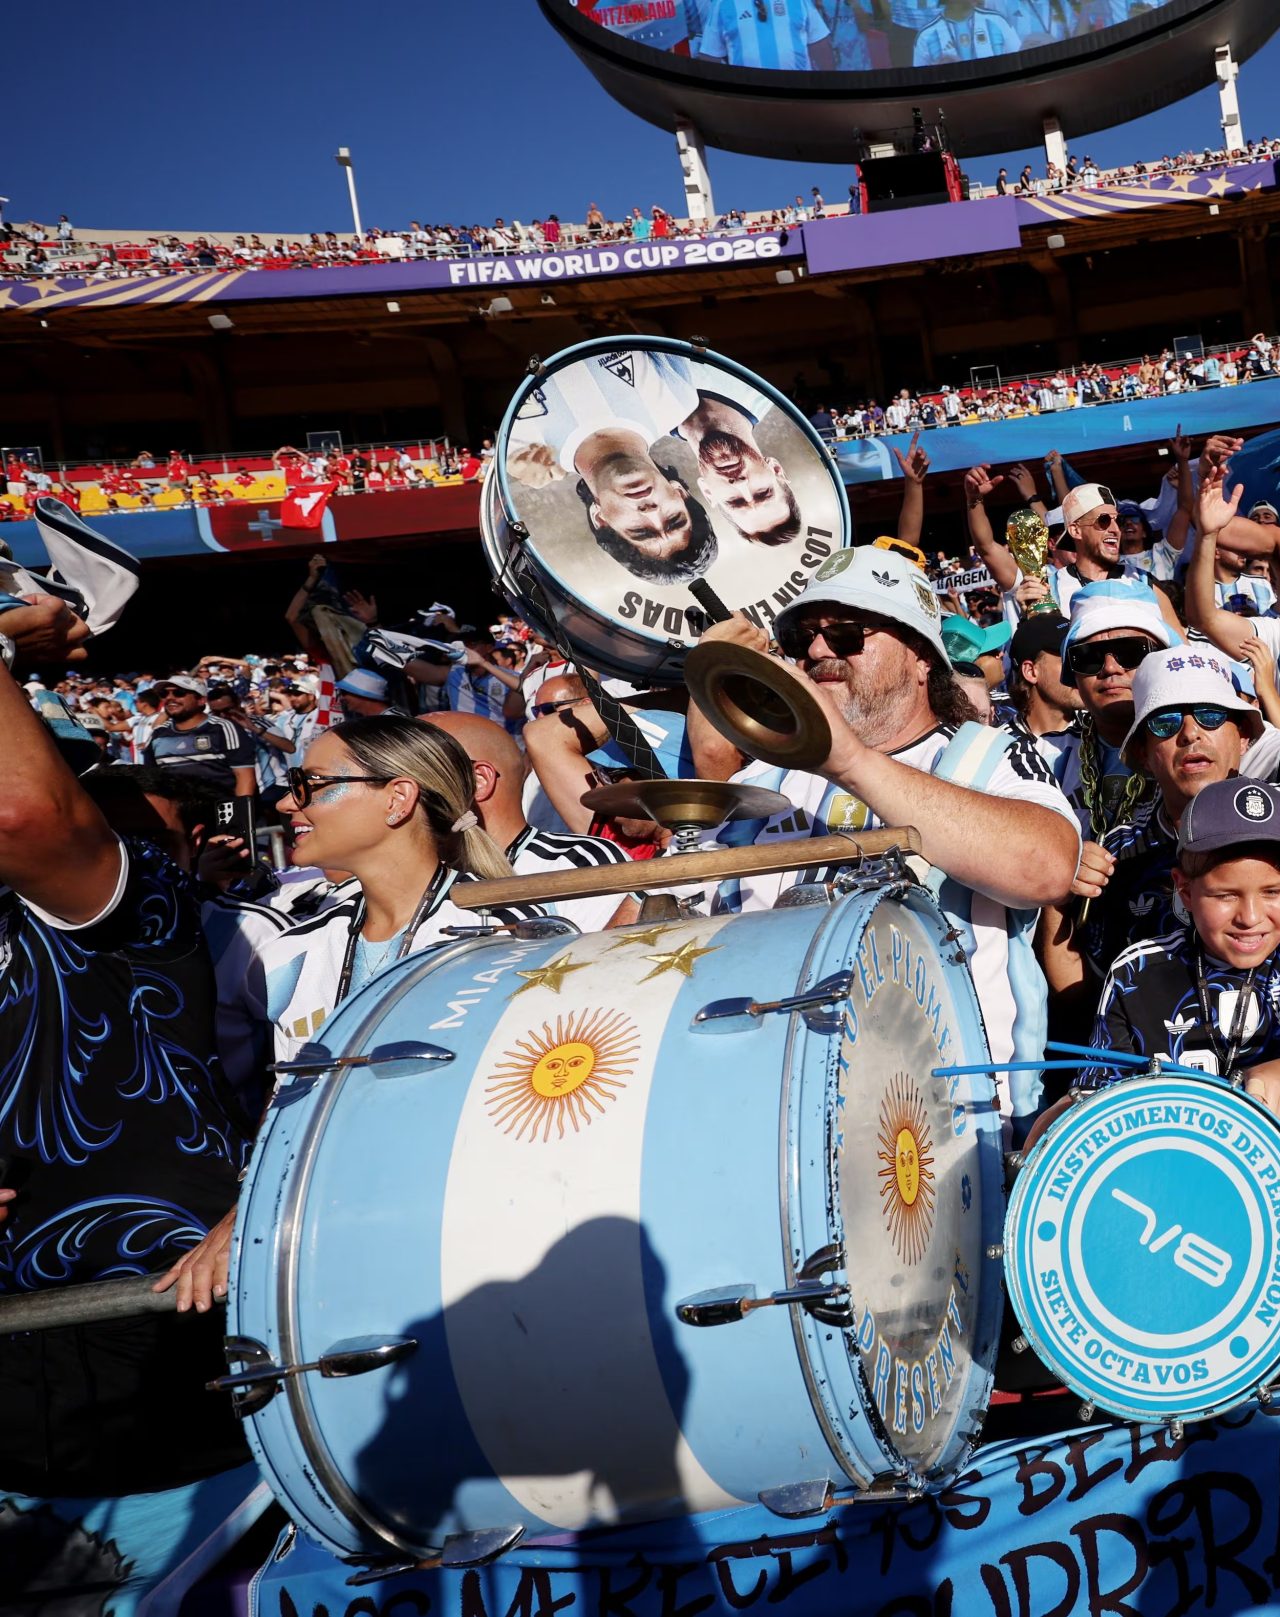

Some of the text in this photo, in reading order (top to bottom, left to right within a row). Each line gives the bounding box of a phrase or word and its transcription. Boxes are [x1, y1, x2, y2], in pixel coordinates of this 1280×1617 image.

[449, 236, 781, 284] FIFA WORLD CUP 2026
[1123, 415, 1132, 432] A
[800, 526, 833, 570] LOS
[1047, 1105, 1234, 1203] INSTRUMENTOS
[1232, 1131, 1263, 1168] DE
[1040, 1269, 1210, 1386] SIETE OCTAVOS
